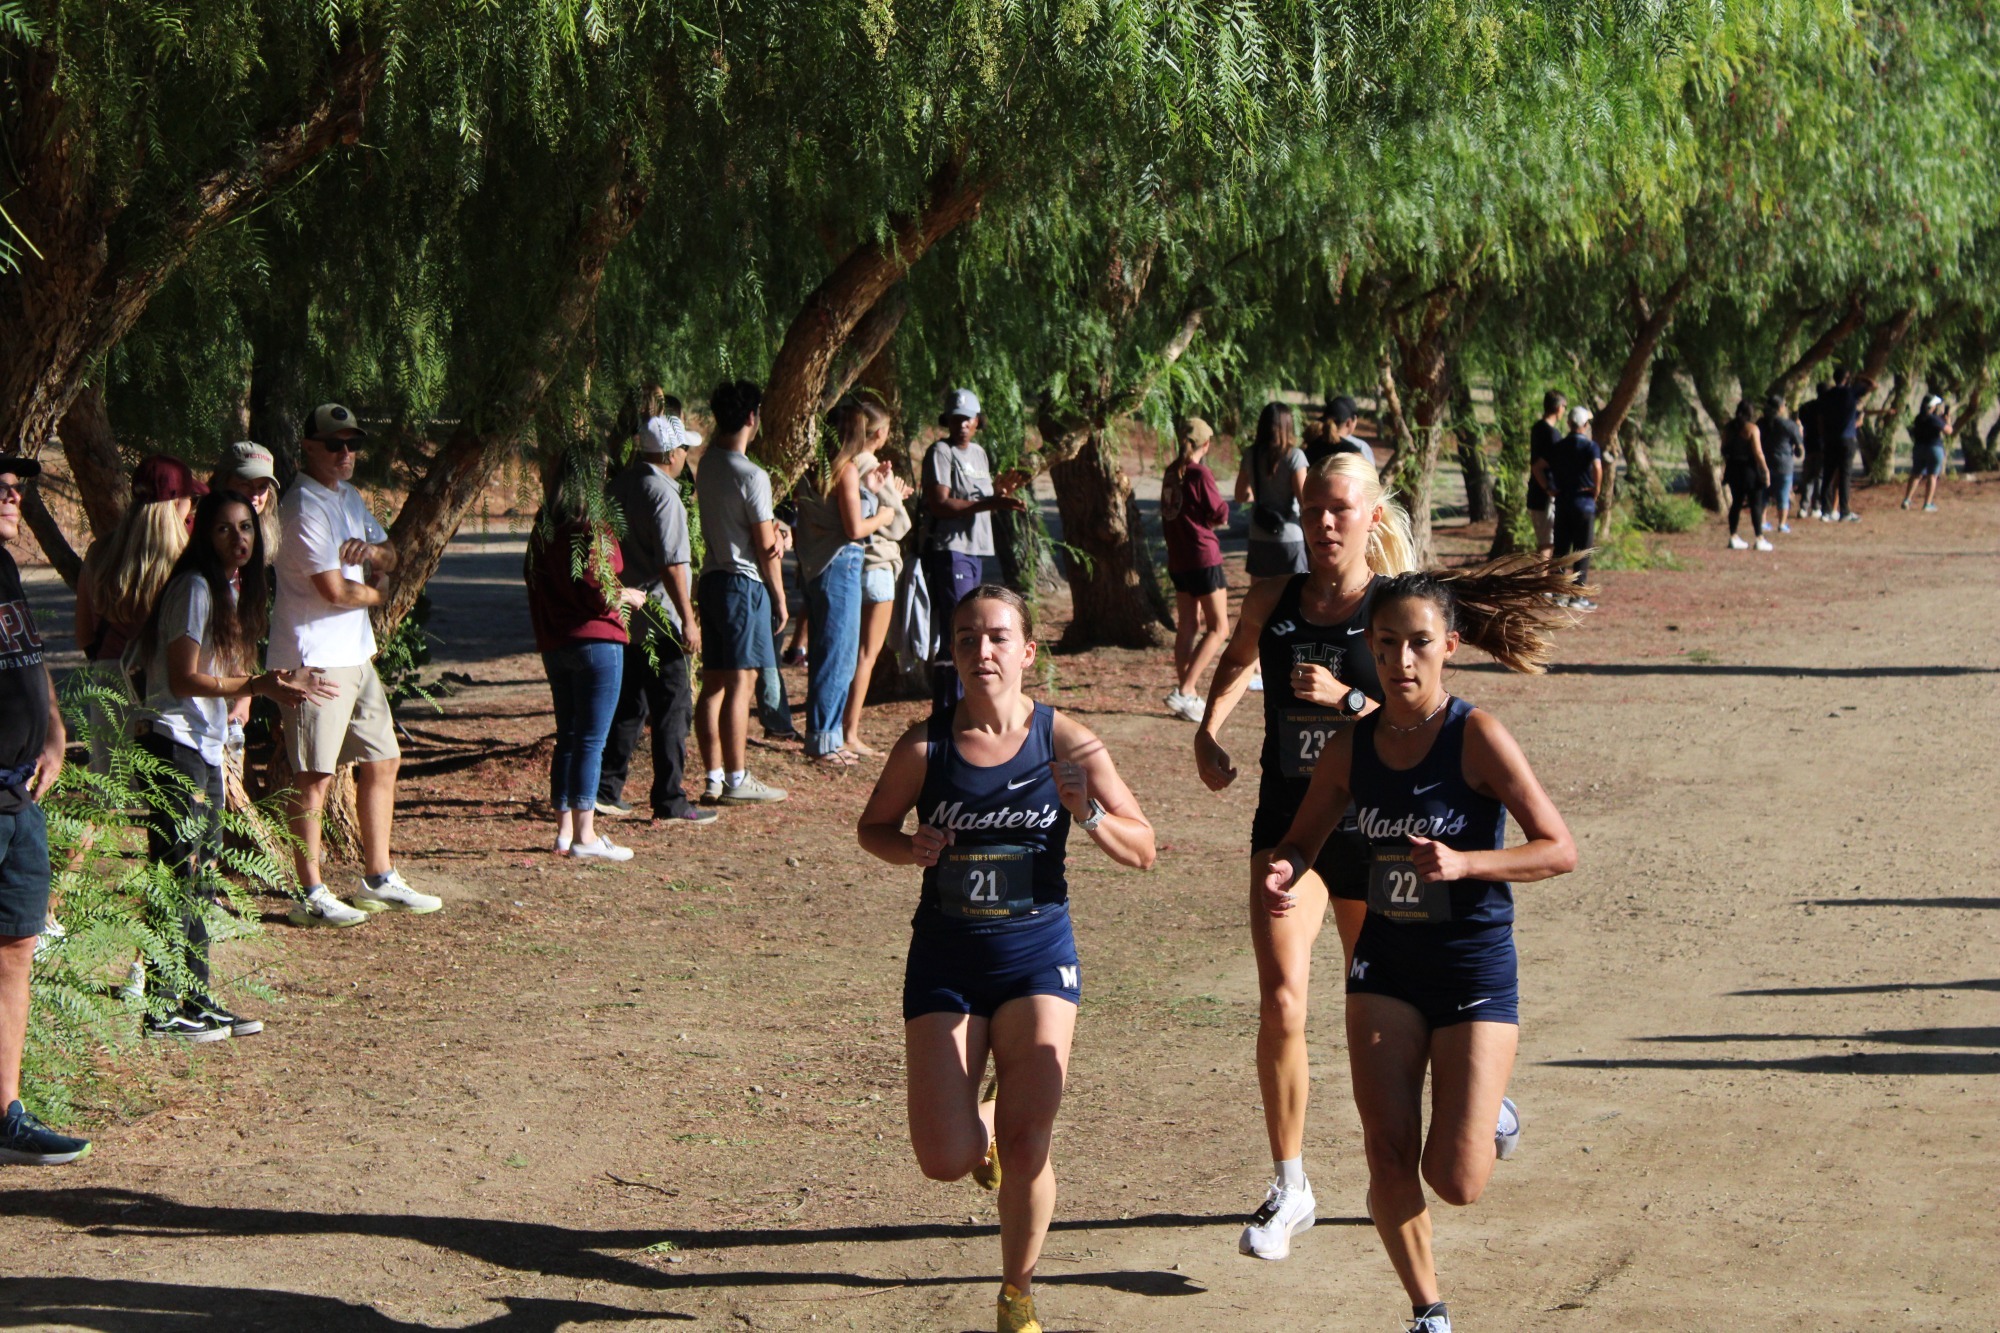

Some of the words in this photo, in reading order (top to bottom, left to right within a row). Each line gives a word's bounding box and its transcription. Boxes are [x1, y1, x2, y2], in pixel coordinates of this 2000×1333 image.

[1299, 730, 1337, 759] 23
[928, 800, 1058, 830] Master's
[1358, 807, 1468, 839] Master's
[960, 854, 988, 862] MASTER'S
[970, 870, 999, 901] 21
[1389, 870, 1419, 903] 22
[970, 908, 1011, 916] INVITATIONAL
[1392, 910, 1429, 919] INVITATIONAL
[1056, 965, 1078, 989] M
